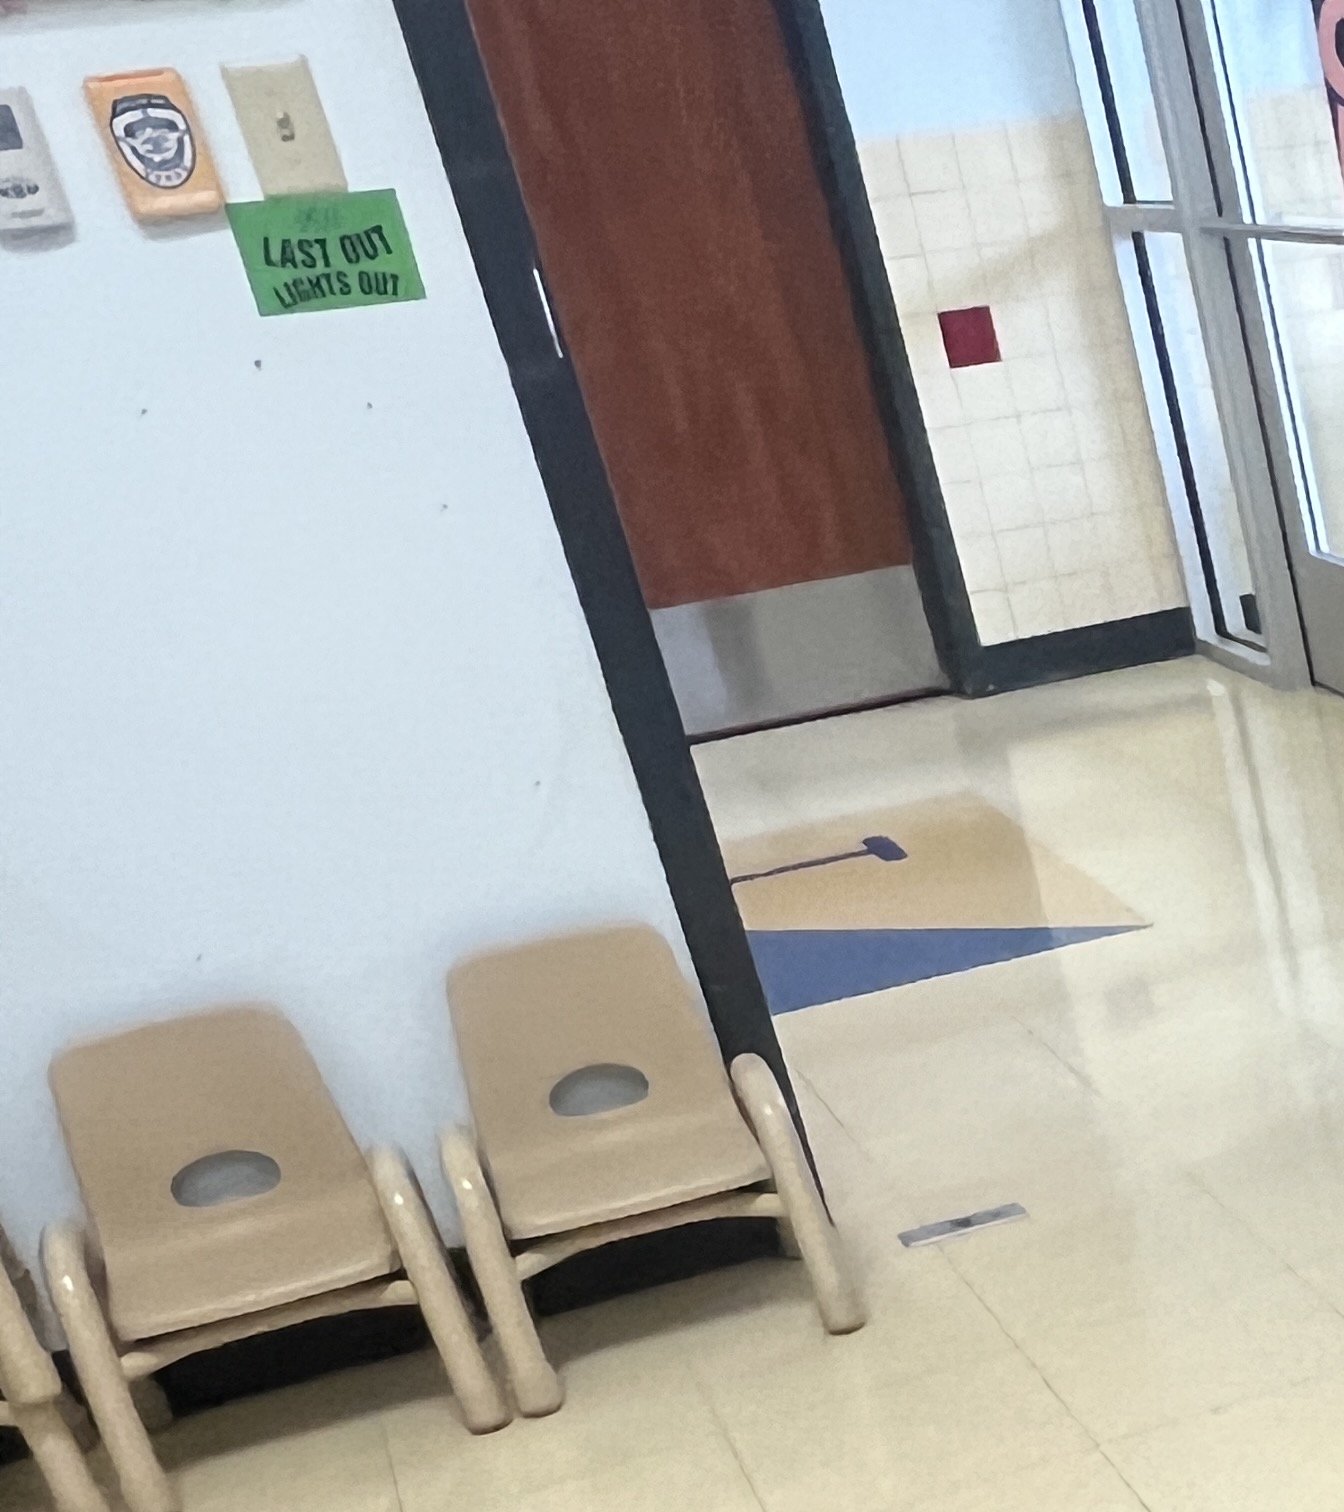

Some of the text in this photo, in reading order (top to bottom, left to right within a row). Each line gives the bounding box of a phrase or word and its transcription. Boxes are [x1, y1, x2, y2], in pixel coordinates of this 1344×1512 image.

[263, 224, 393, 269] LAST OUT
[273, 270, 399, 309] LIGHTS OUT
